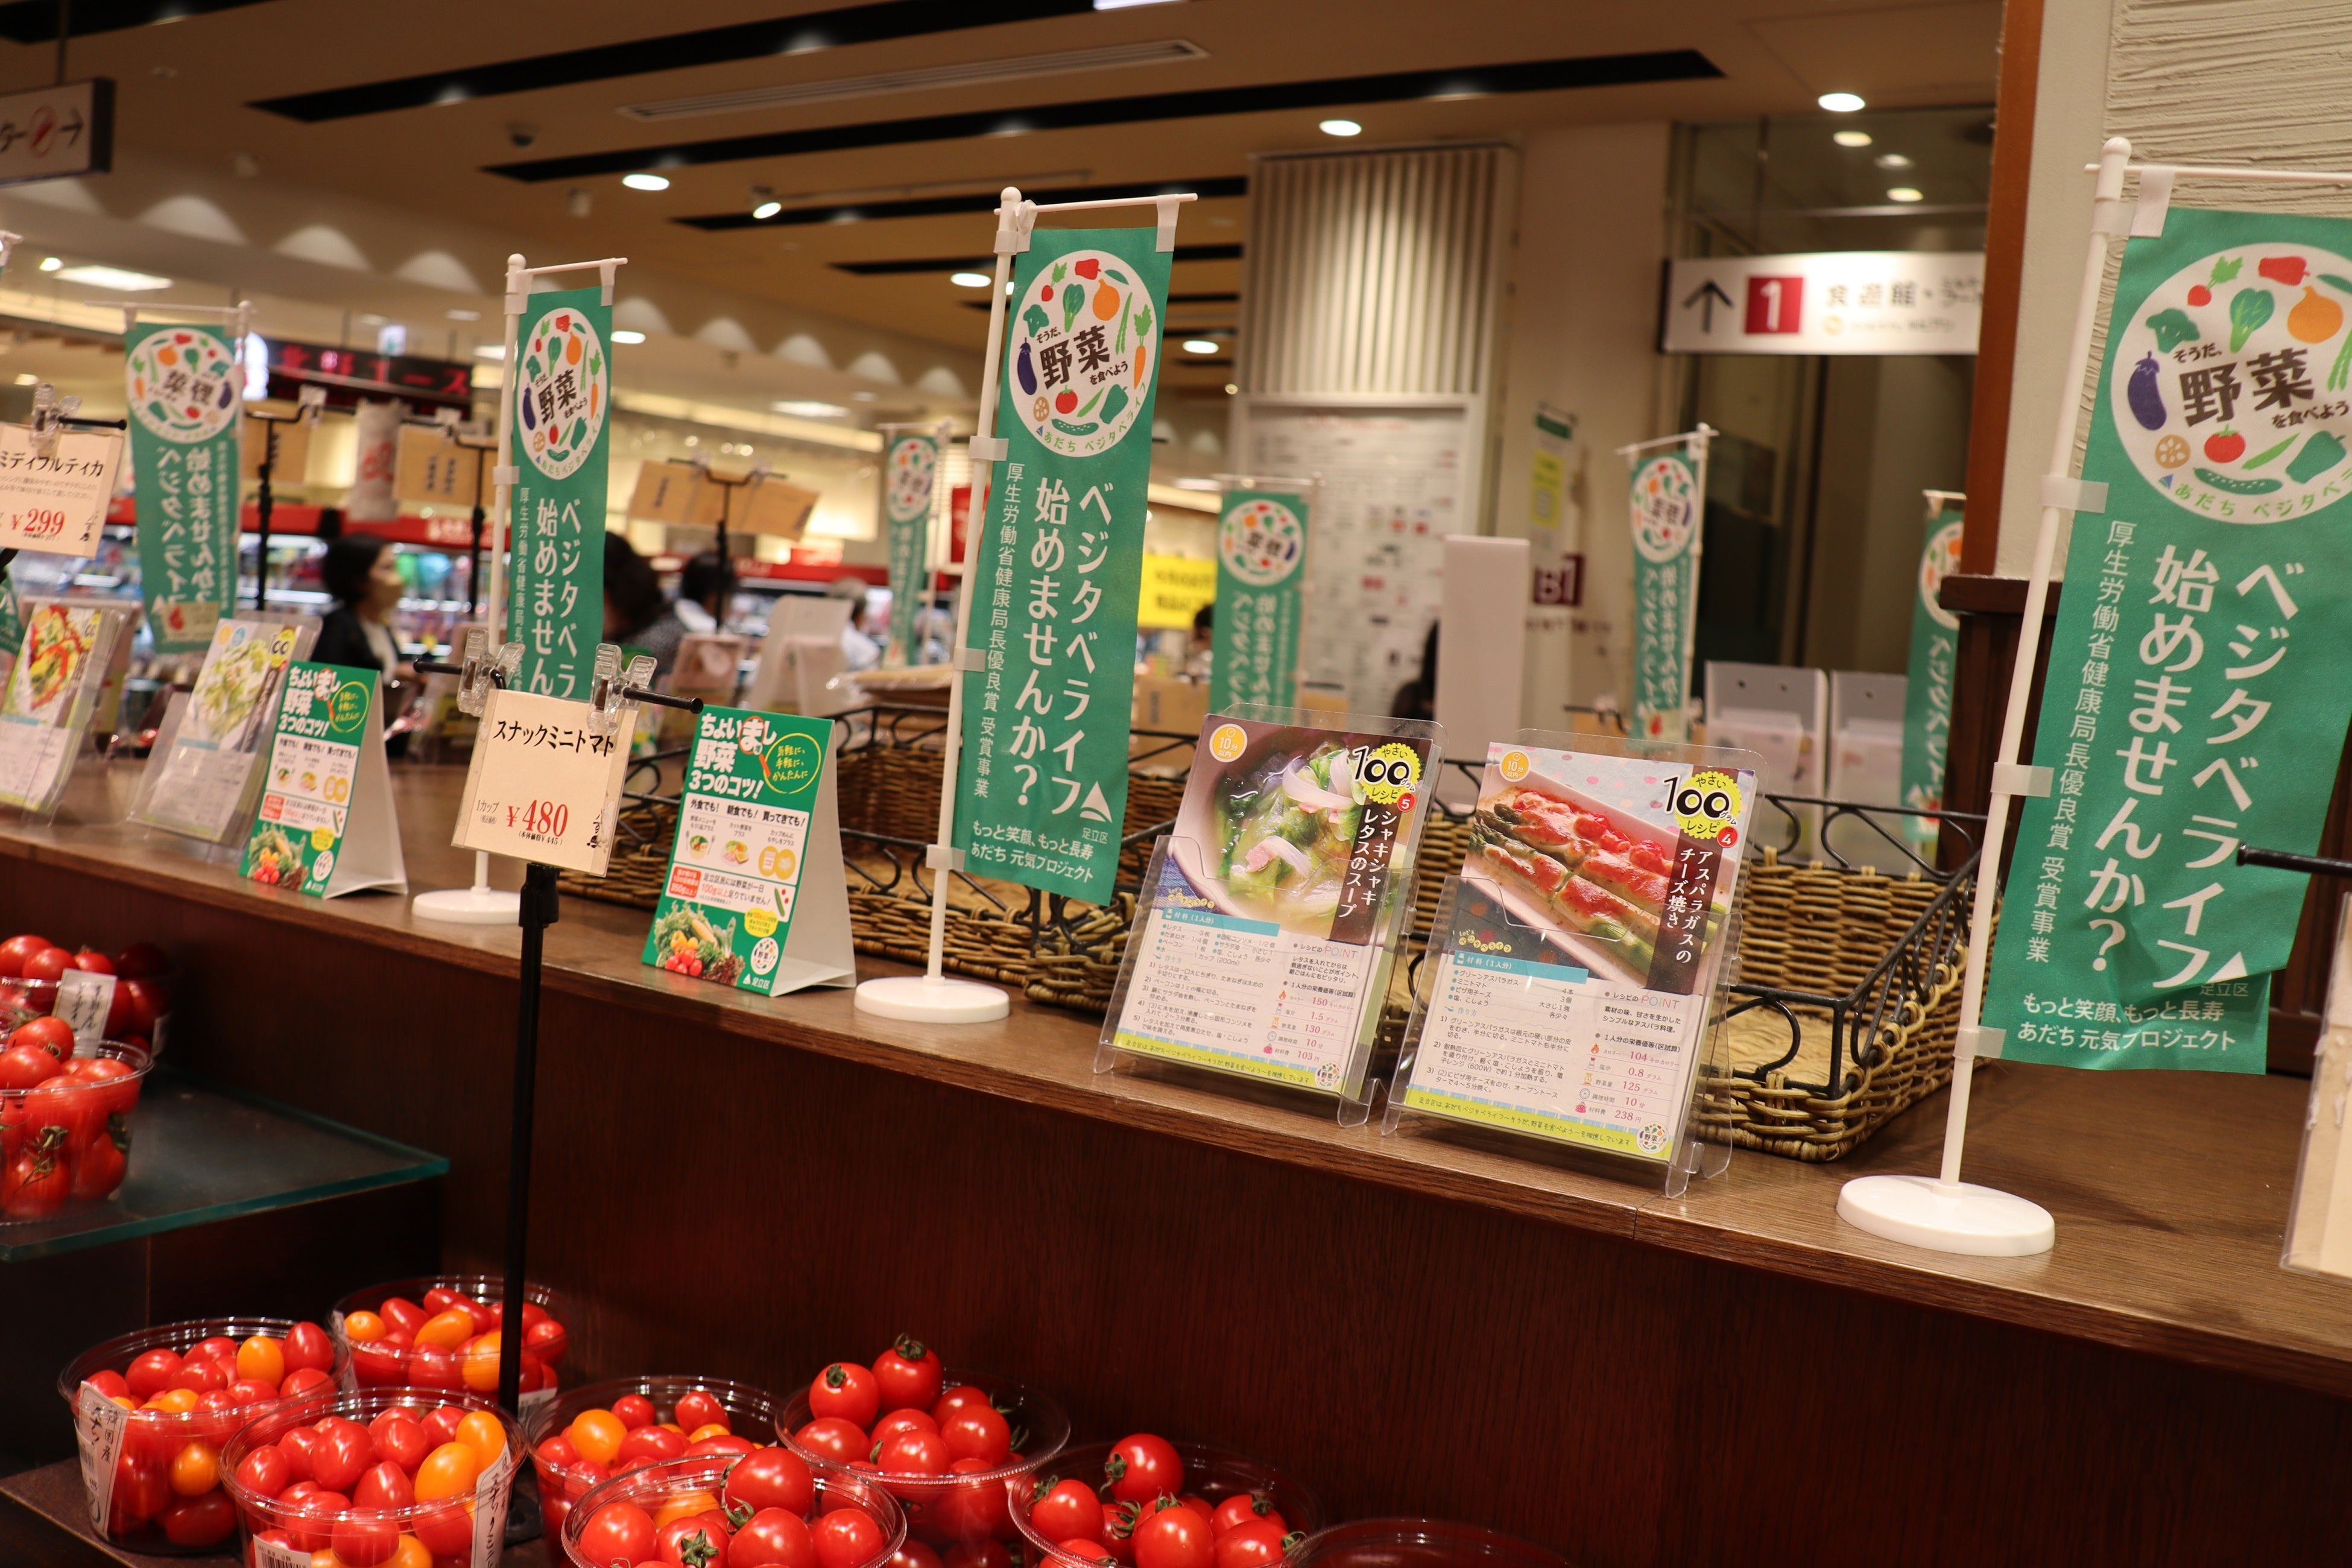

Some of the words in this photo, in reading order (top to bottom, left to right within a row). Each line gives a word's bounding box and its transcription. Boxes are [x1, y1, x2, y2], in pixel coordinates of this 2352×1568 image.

[1037, 327, 1061, 343] そうだ、
[1040, 325, 1109, 389] 野菜
[2173, 343, 2222, 363] そうだ、
[1090, 361, 1128, 385] を食べよう
[2179, 347, 2315, 428] 野菜
[538, 370, 577, 424] 野菜
[2272, 401, 2350, 429] を食べよう
[2175, 483, 2235, 516] あだち
[1052, 483, 1113, 814] ベジタベライフ
[493, 721, 614, 757] スナックミニトマト
[694, 739, 738, 773] 野菜
[1382, 746, 1408, 758] やさい
[1353, 746, 1410, 786] 100
[773, 770, 808, 782] かんたんに
[1696, 776, 1727, 788] やさい
[2153, 562, 2304, 988] ベジタベライフ
[689, 770, 764, 799] 3つのコツ!
[1371, 788, 1401, 799] レシピ
[1663, 776, 1730, 818] 100
[1401, 799, 1410, 809] 5
[1687, 821, 1720, 833] レシピ
[1082, 827, 1108, 844] 足立区
[1721, 833, 1732, 844] 4
[971, 841, 1006, 862] あだち
[1010, 849, 1093, 883] 元気プロジェクト
[1339, 809, 1379, 918] レタスのスープ
[1361, 812, 1397, 905] シャキシャキ
[1666, 849, 1695, 929] チーズ焼き
[1676, 851, 1714, 964] アスパラガスの
[1324, 946, 1358, 959] POINT
[1457, 979, 1487, 988] ミニトマト
[1459, 970, 1519, 985] グリーンアスパラガス
[2199, 983, 2248, 997] 足立区
[1312, 997, 1328, 1007] 150
[1641, 995, 1680, 1010] POINT
[1310, 1012, 1324, 1021] 1.5
[1305, 1024, 1320, 1034] 130
[2017, 1022, 2076, 1047] あだち
[2080, 1031, 2236, 1051] 元気プロジェクト
[1306, 1038, 1317, 1048] 10
[1629, 1051, 1648, 1062] 104
[1628, 1067, 1644, 1078] 0.8
[1622, 1081, 1640, 1092] 125
[1625, 1097, 1637, 1107] 10
[1614, 1110, 1634, 1121] 238
